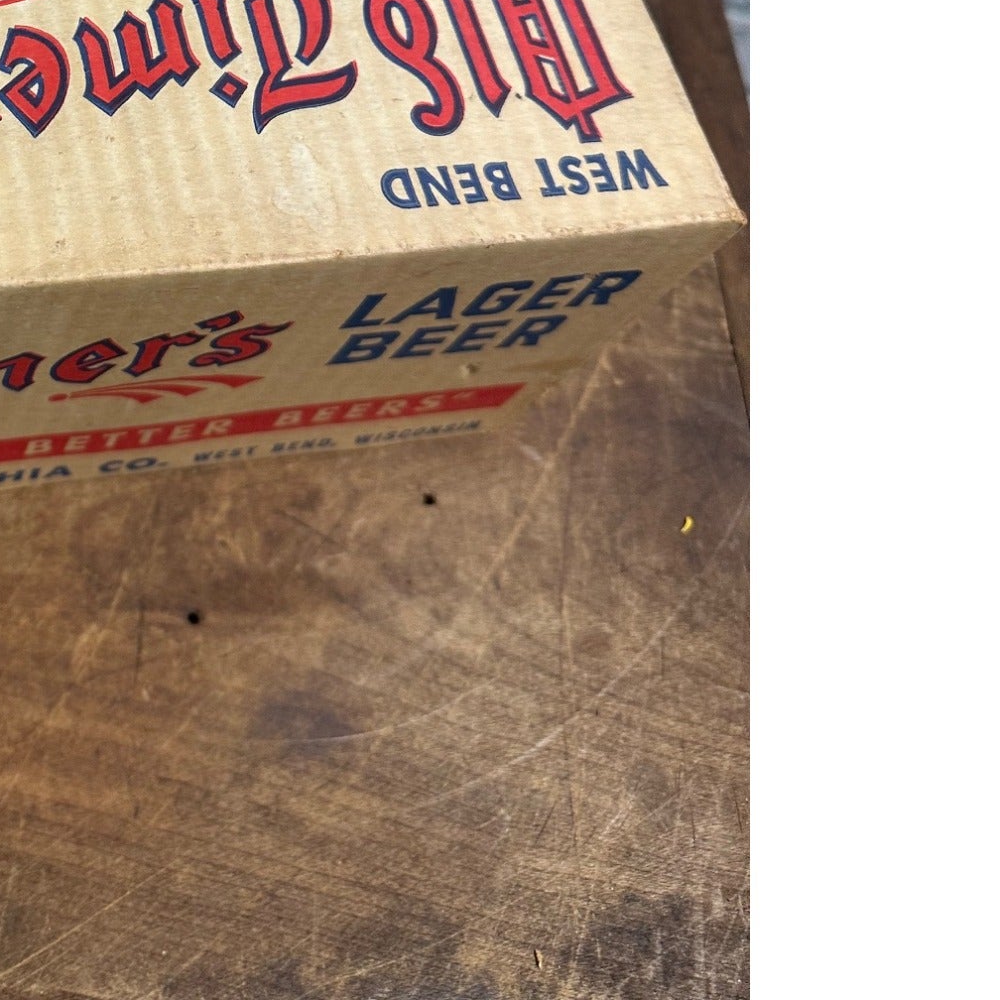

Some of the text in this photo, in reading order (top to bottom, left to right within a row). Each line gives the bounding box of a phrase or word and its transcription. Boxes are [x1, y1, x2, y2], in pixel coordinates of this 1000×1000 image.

[380, 148, 669, 210] WEST BEND
[340, 268, 644, 330] LAGER
[326, 314, 568, 367] BEER
[24, 418, 233, 456] BETTER
[273, 390, 478, 427] BEERS"
[98, 455, 168, 474] CO.
[193, 443, 258, 463] WEST
[354, 419, 482, 446] WISCONSIN
